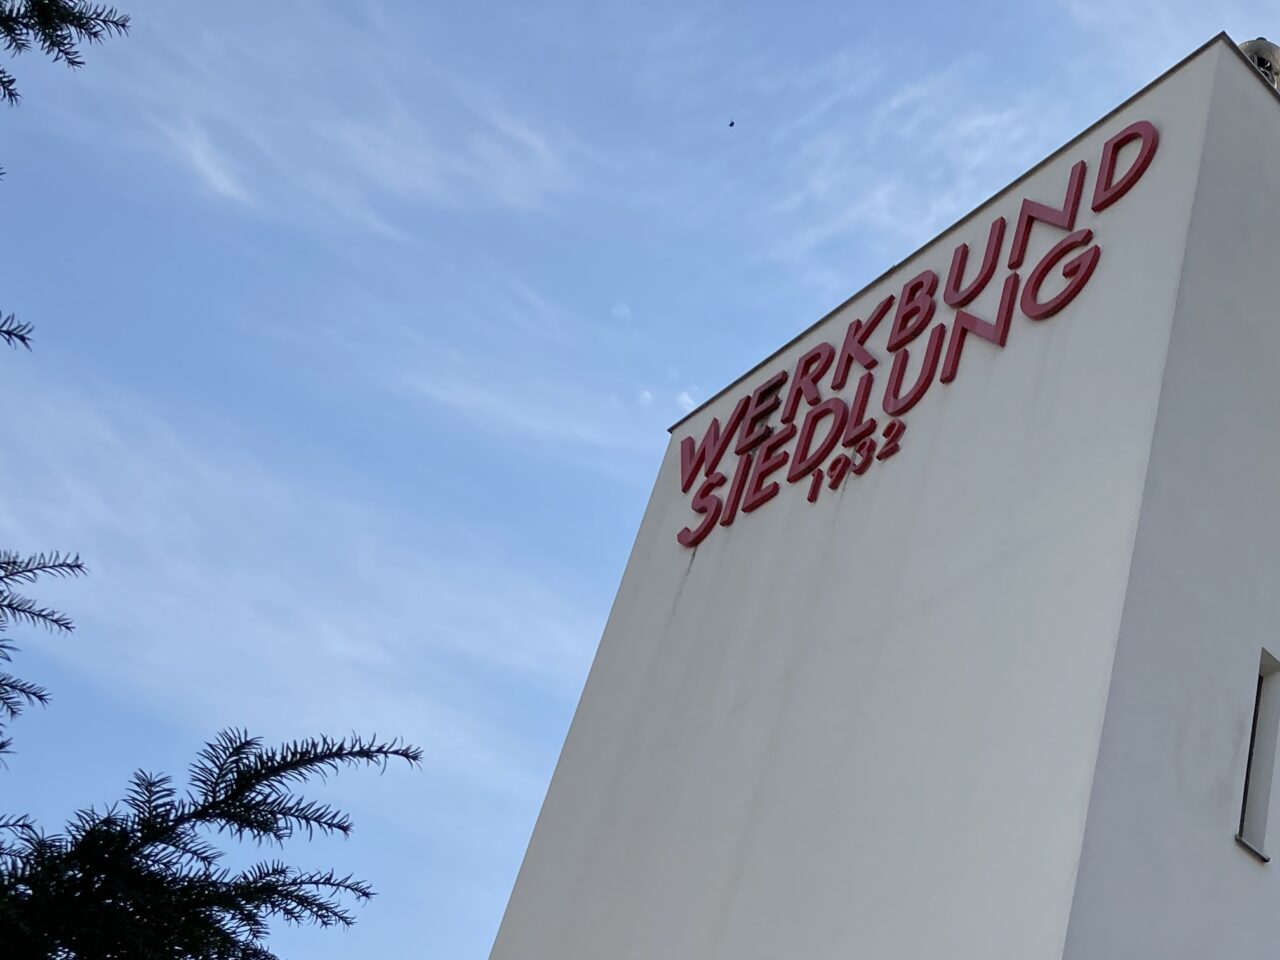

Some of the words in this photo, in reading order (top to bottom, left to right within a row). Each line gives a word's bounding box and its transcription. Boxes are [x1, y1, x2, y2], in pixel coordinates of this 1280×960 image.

[677, 228, 1101, 548] SIEDLUNG
[680, 120, 1159, 493] WERKBUND
[807, 418, 907, 503] 1932
